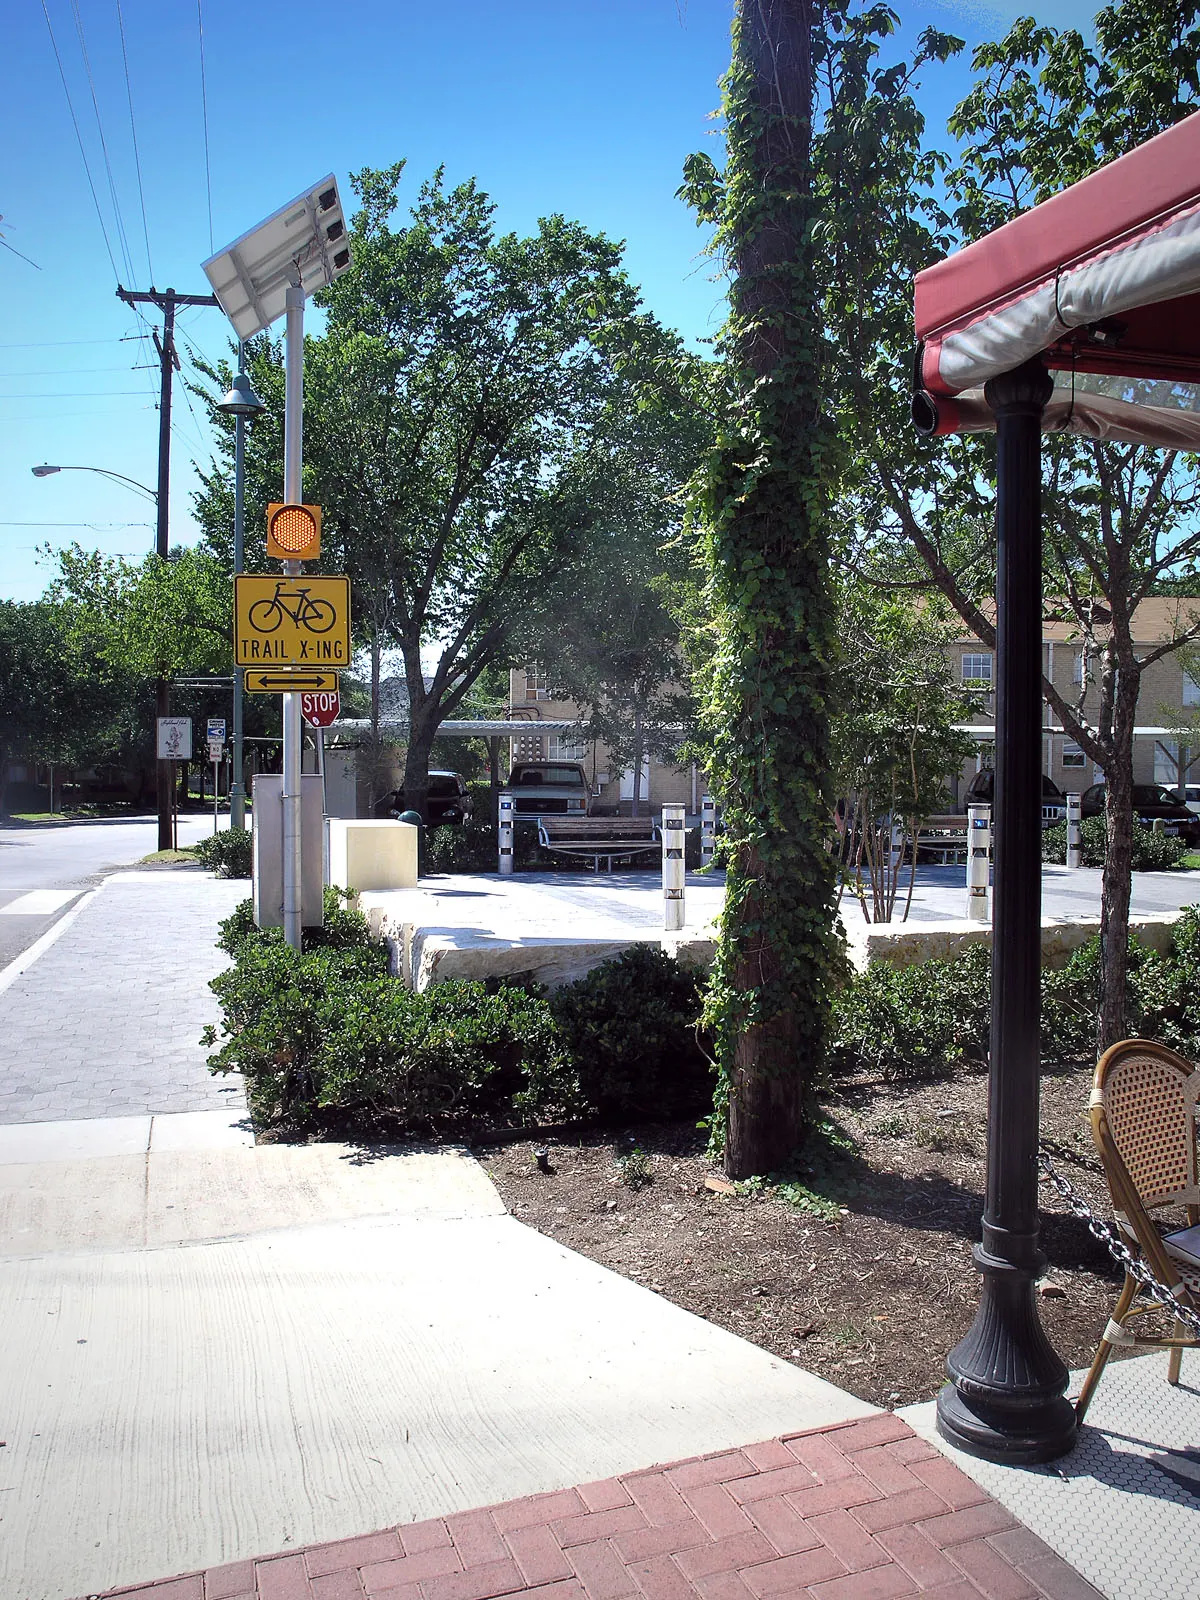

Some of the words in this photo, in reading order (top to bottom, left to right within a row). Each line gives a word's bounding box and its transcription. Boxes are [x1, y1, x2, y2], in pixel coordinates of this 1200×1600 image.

[241, 640, 289, 659] TRAIL
[300, 640, 343, 659] X-ING
[303, 693, 337, 713] STOP
